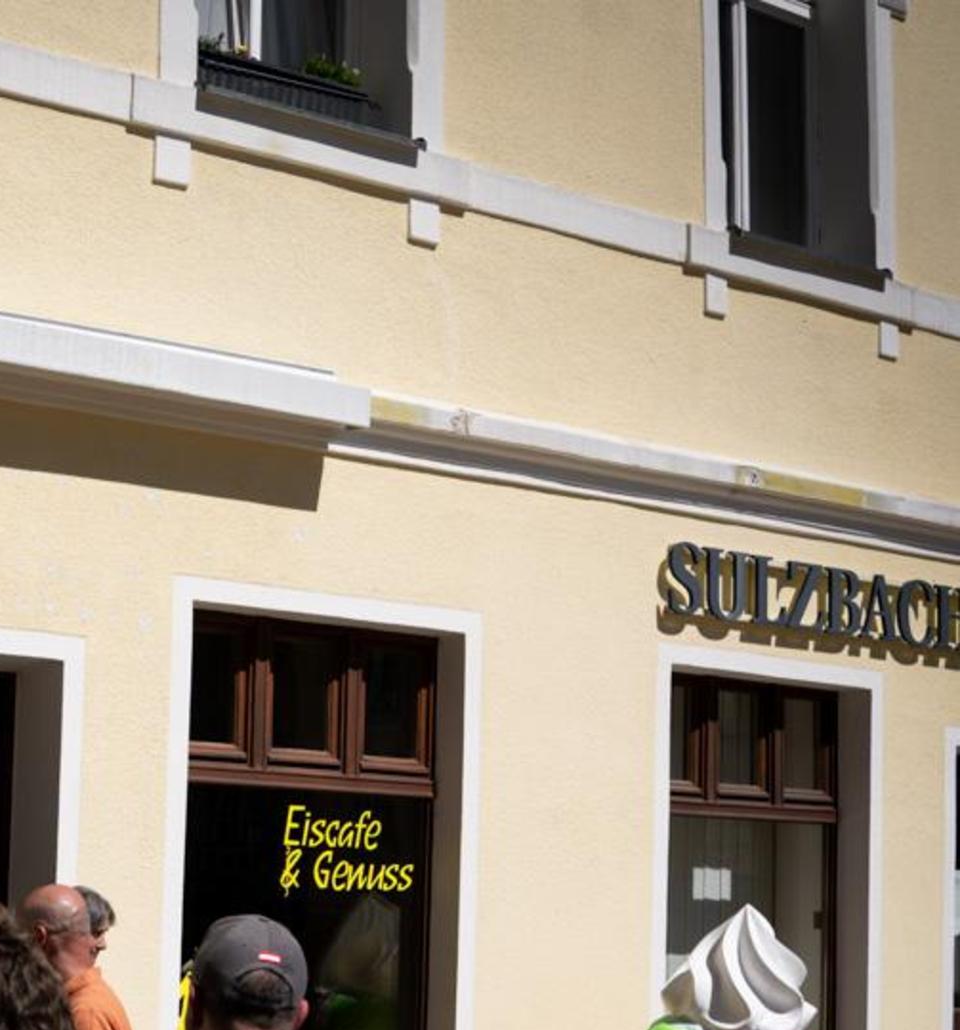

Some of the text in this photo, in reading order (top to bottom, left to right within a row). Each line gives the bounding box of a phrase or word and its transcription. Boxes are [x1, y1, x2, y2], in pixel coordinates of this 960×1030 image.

[283, 804, 382, 850] Eiscafe
[280, 848, 415, 897] & Genuss
